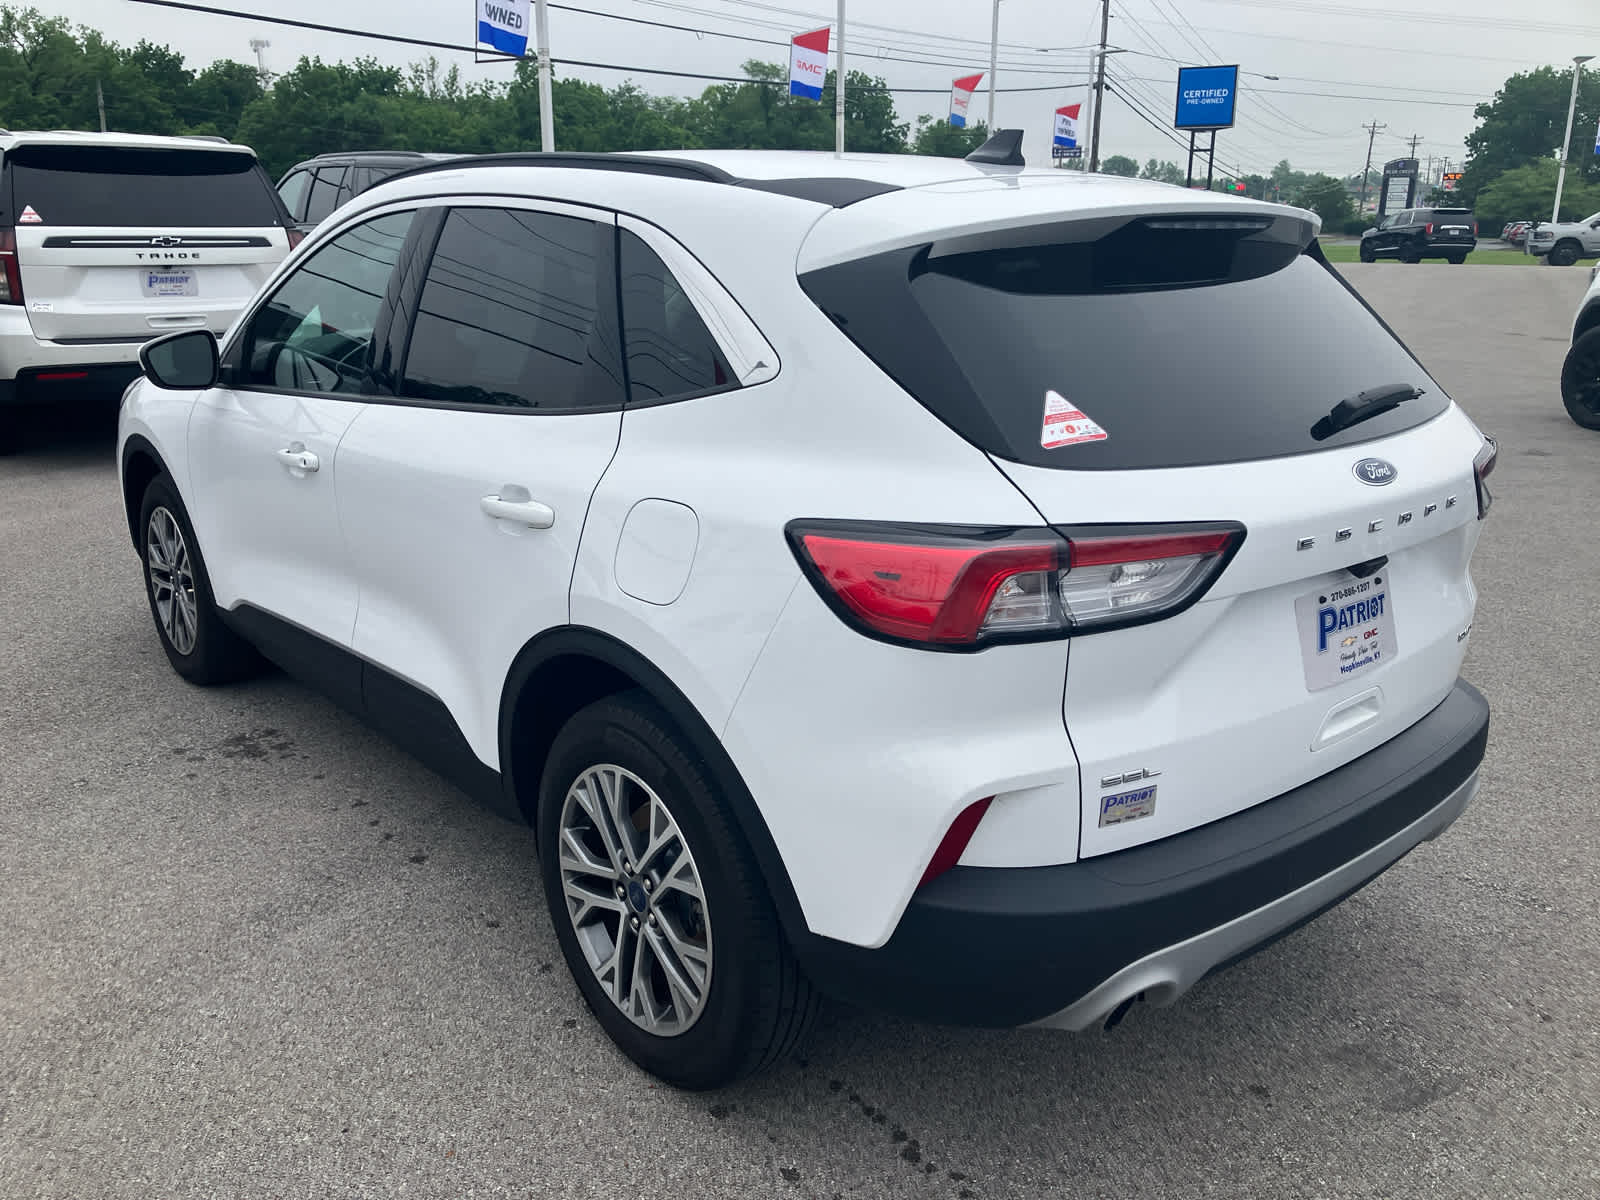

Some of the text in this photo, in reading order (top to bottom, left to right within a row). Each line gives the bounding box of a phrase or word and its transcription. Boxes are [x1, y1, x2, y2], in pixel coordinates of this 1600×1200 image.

[1183, 88, 1229, 98] CERTIFIED
[1186, 97, 1224, 105] PRE-OWNED
[135, 252, 200, 260] TAHOE
[1365, 462, 1391, 479] Ford
[1296, 494, 1457, 552] ESCAPE
[1318, 594, 1385, 652] PATRIOT
[1101, 768, 1162, 788] SEL
[1104, 788, 1155, 814] PATRIOT
